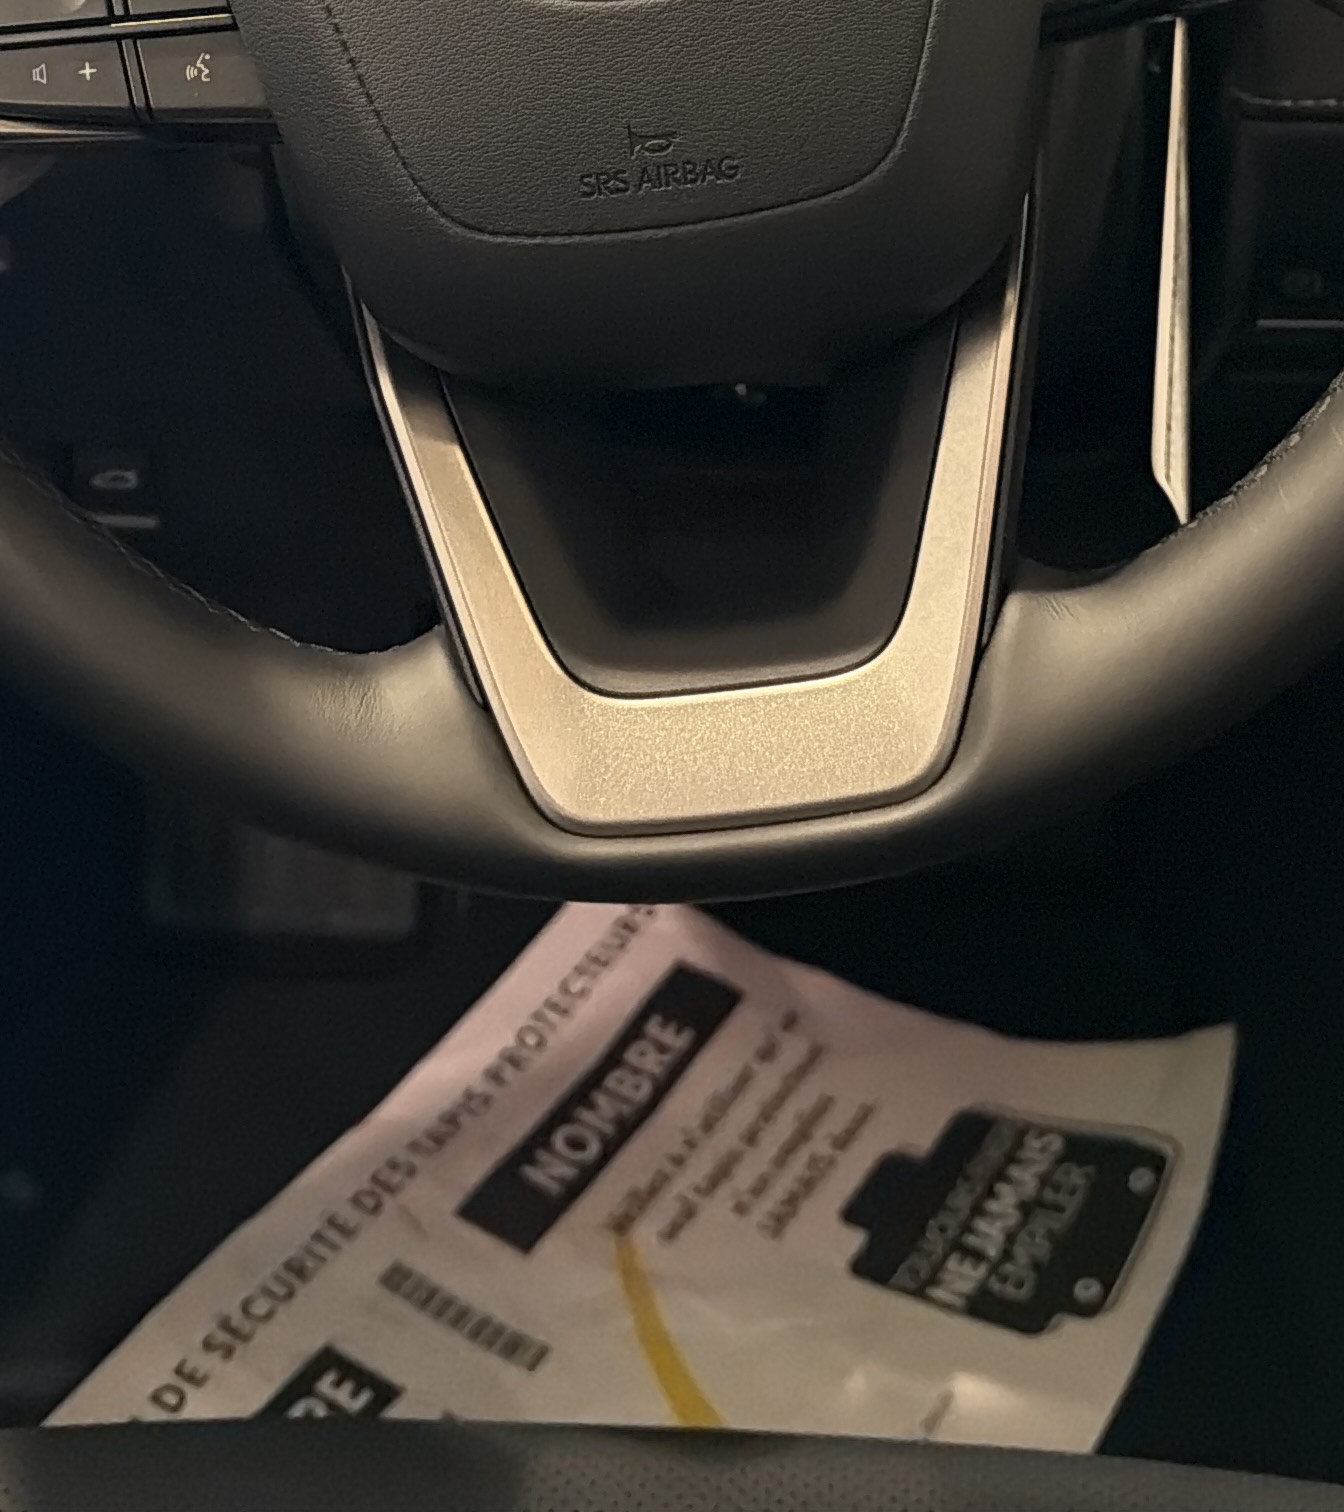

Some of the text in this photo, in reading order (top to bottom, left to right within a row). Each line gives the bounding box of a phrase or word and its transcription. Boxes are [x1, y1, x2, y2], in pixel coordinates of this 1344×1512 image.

[579, 156, 742, 200] SRS AIRBAG
[519, 1014, 697, 1196] NOMBRE
[149, 1357, 210, 1414] DE
[351, 1152, 417, 1218] DES
[925, 1250, 991, 1307] NE
[960, 1132, 1067, 1263] JAMAIS
